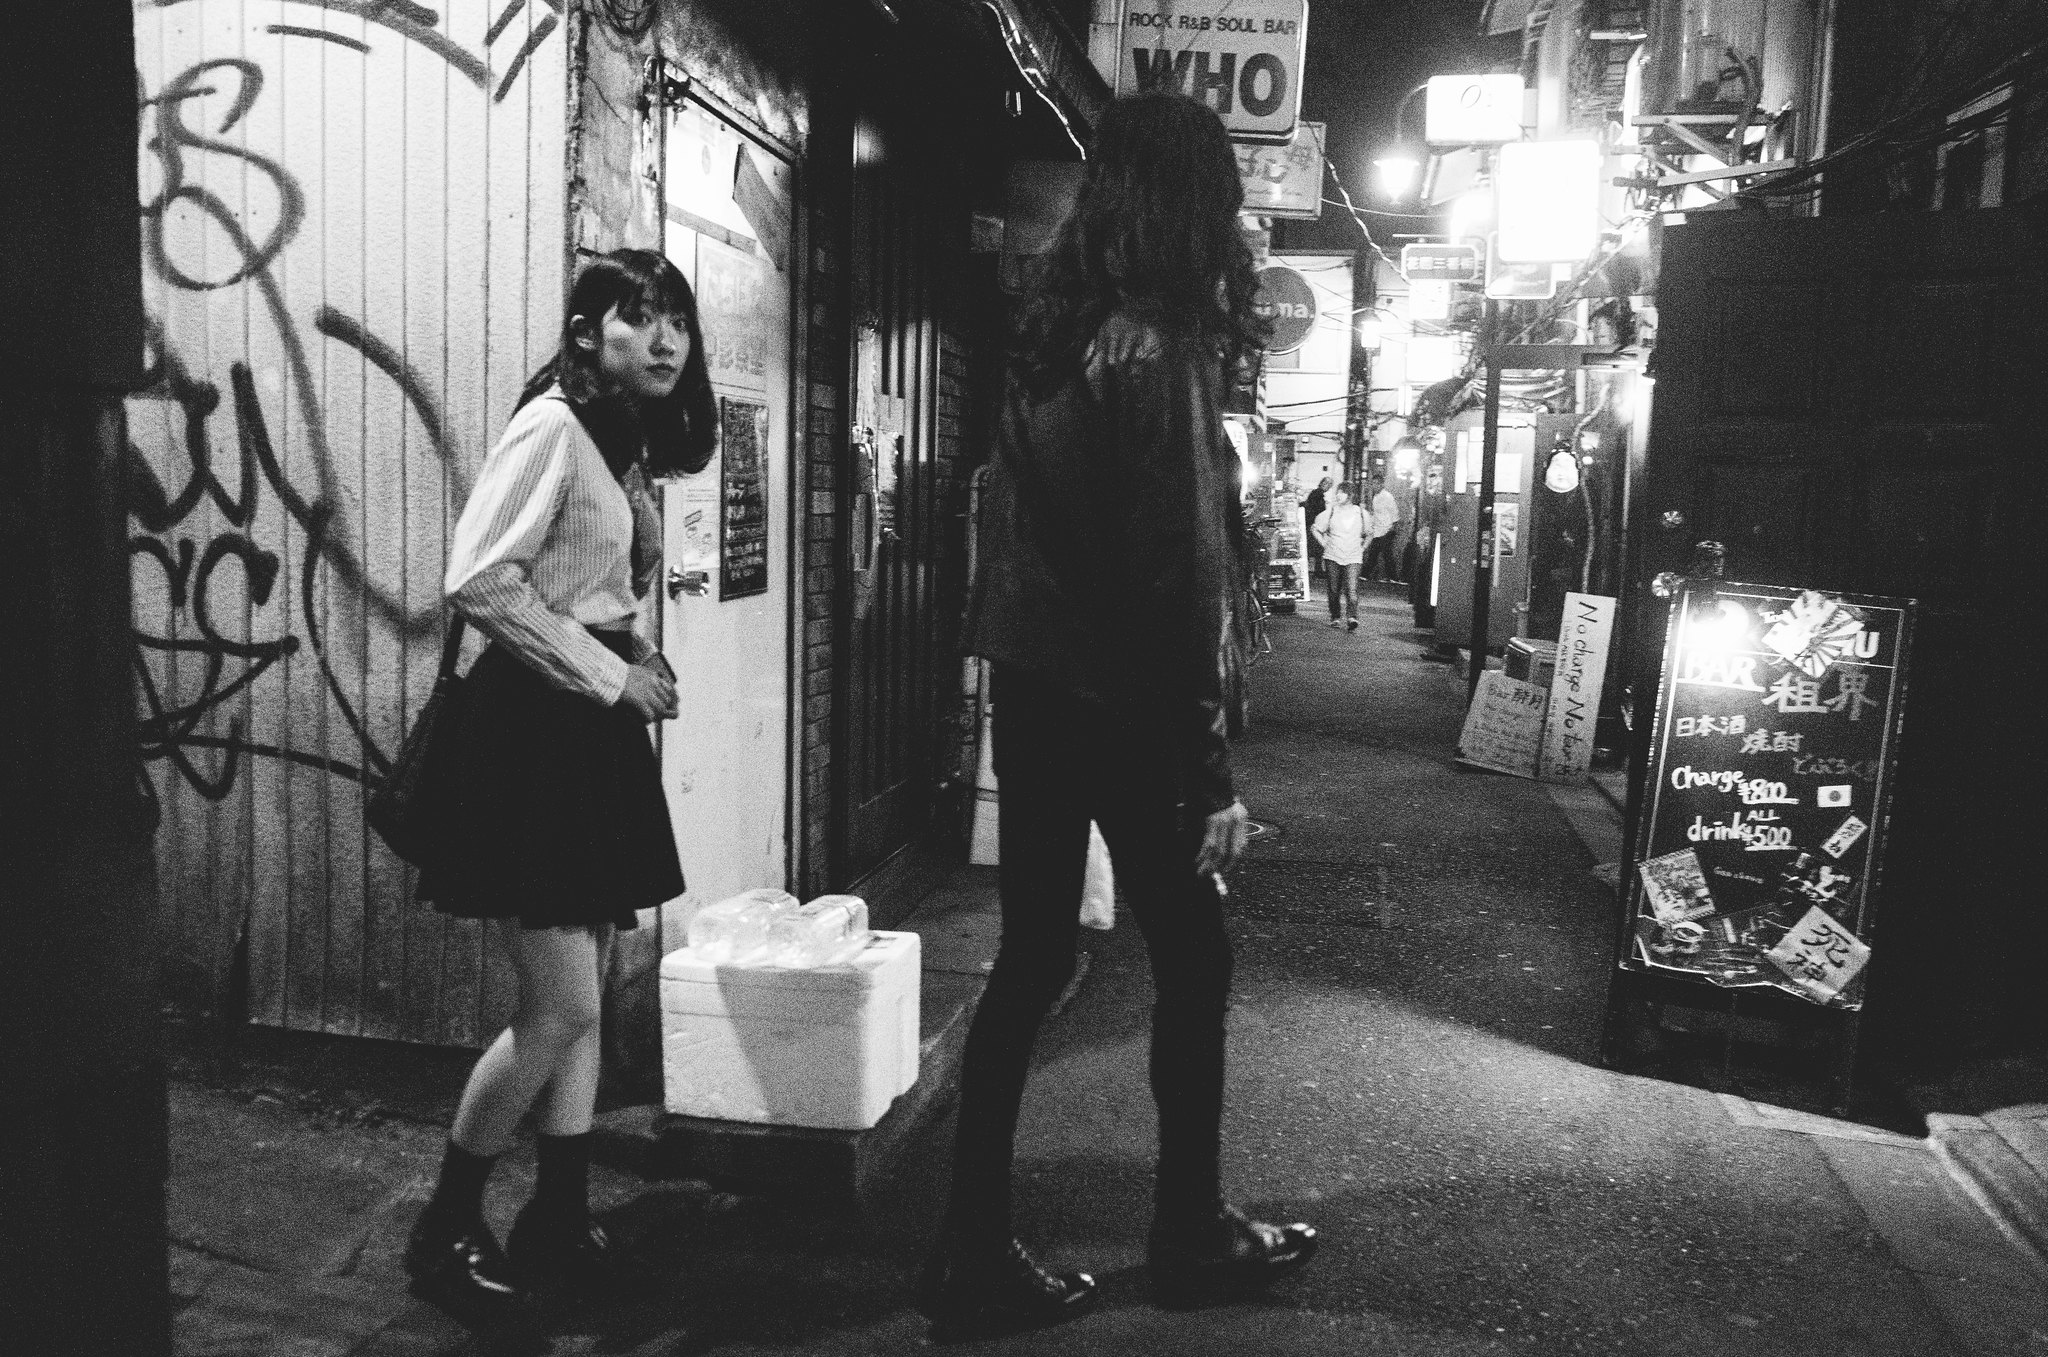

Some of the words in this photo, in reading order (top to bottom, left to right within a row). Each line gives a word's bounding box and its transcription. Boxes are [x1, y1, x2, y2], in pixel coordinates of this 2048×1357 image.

[1129, 13, 1173, 28] ROCK
[1179, 15, 1211, 31] R&B
[1217, 17, 1257, 33] SOUL
[1263, 20, 1297, 35] BAR
[1132, 48, 1288, 117] WHO
[1577, 601, 1599, 634] No
[1564, 639, 1596, 693] charge
[1762, 671, 1877, 721] 租界
[1563, 697, 1585, 729] No
[1676, 715, 1747, 737] 日本酒
[1671, 766, 1744, 792] Charge
[1737, 780, 1788, 800] ¥800
[1687, 812, 1748, 842] drink
[1746, 810, 1780, 821] ALL
